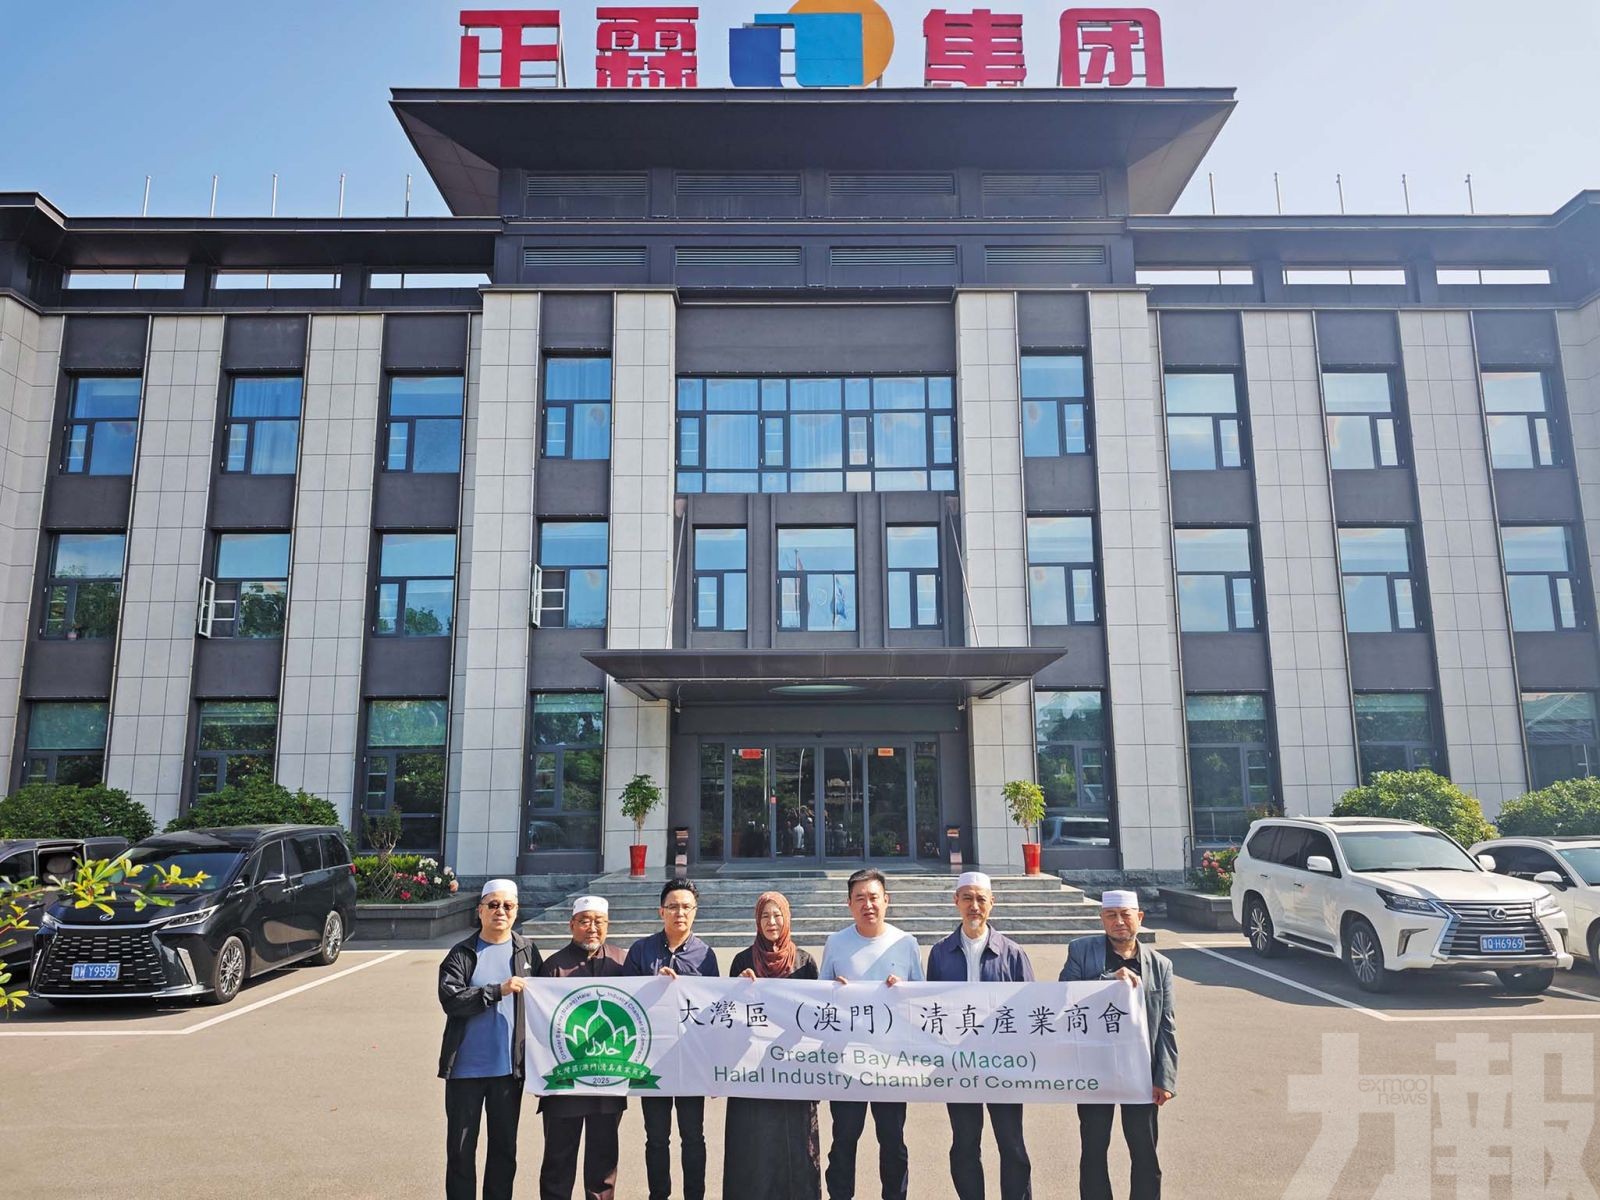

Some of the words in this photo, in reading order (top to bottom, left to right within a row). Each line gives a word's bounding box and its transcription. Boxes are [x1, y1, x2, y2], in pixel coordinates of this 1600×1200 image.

[459, 10, 698, 88] 正霖
[924, 8, 1164, 88] 集团
[680, 999, 1129, 1035] 大灣區（澳門）清真產業商會
[770, 1046, 846, 1064] Greater
[853, 1050, 890, 1070] Bay
[896, 1051, 945, 1068] Area
[952, 1051, 1036, 1070] (Macao)
[714, 1066, 765, 1083] Halal
[772, 1067, 852, 1089] Industry
[859, 1072, 954, 1088] Chamber
[959, 1073, 979, 1089] of
[984, 1075, 1099, 1091] Commerce
